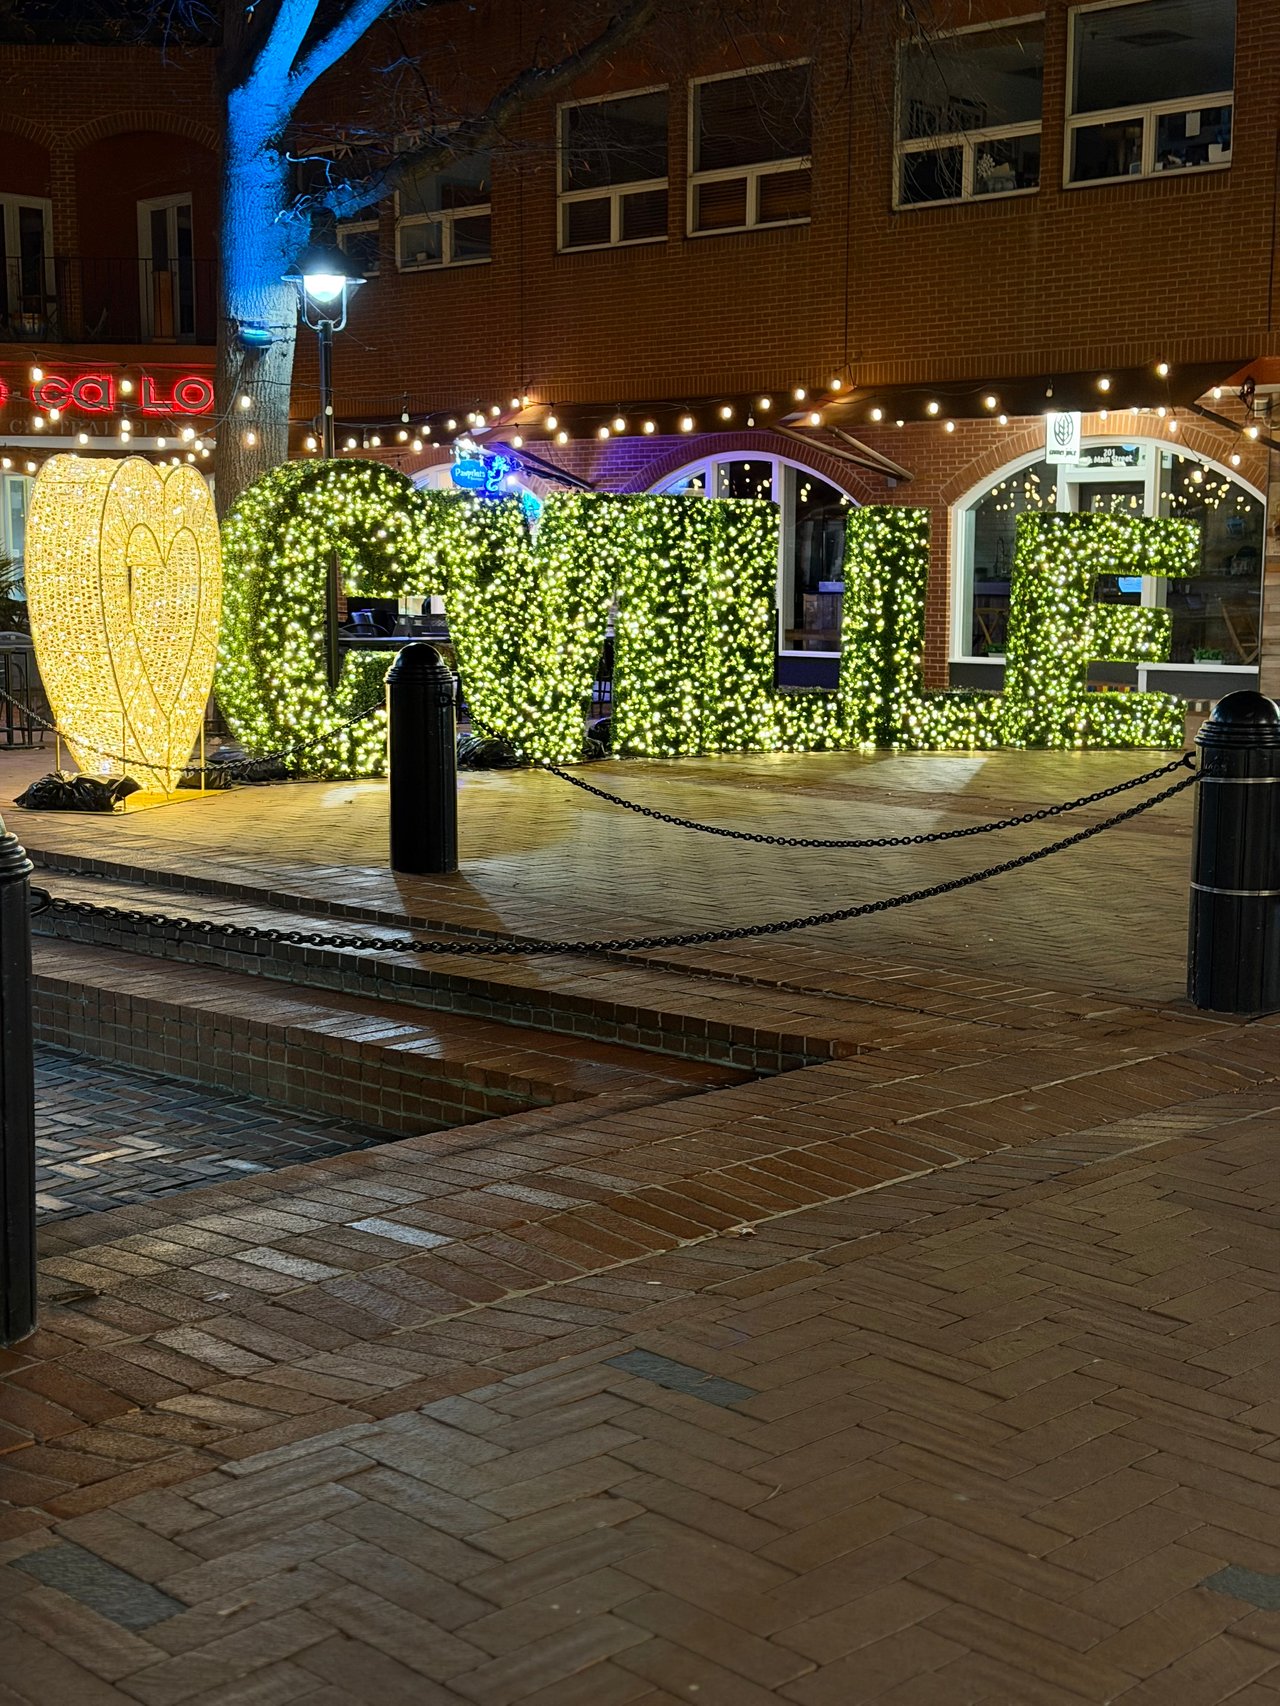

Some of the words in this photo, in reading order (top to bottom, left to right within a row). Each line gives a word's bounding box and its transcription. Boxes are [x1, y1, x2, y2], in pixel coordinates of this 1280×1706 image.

[1103, 448, 1116, 458] 201
[1093, 455, 1111, 464] Main
[1111, 454, 1134, 464] Street
[455, 467, 486, 480] Pawprints
